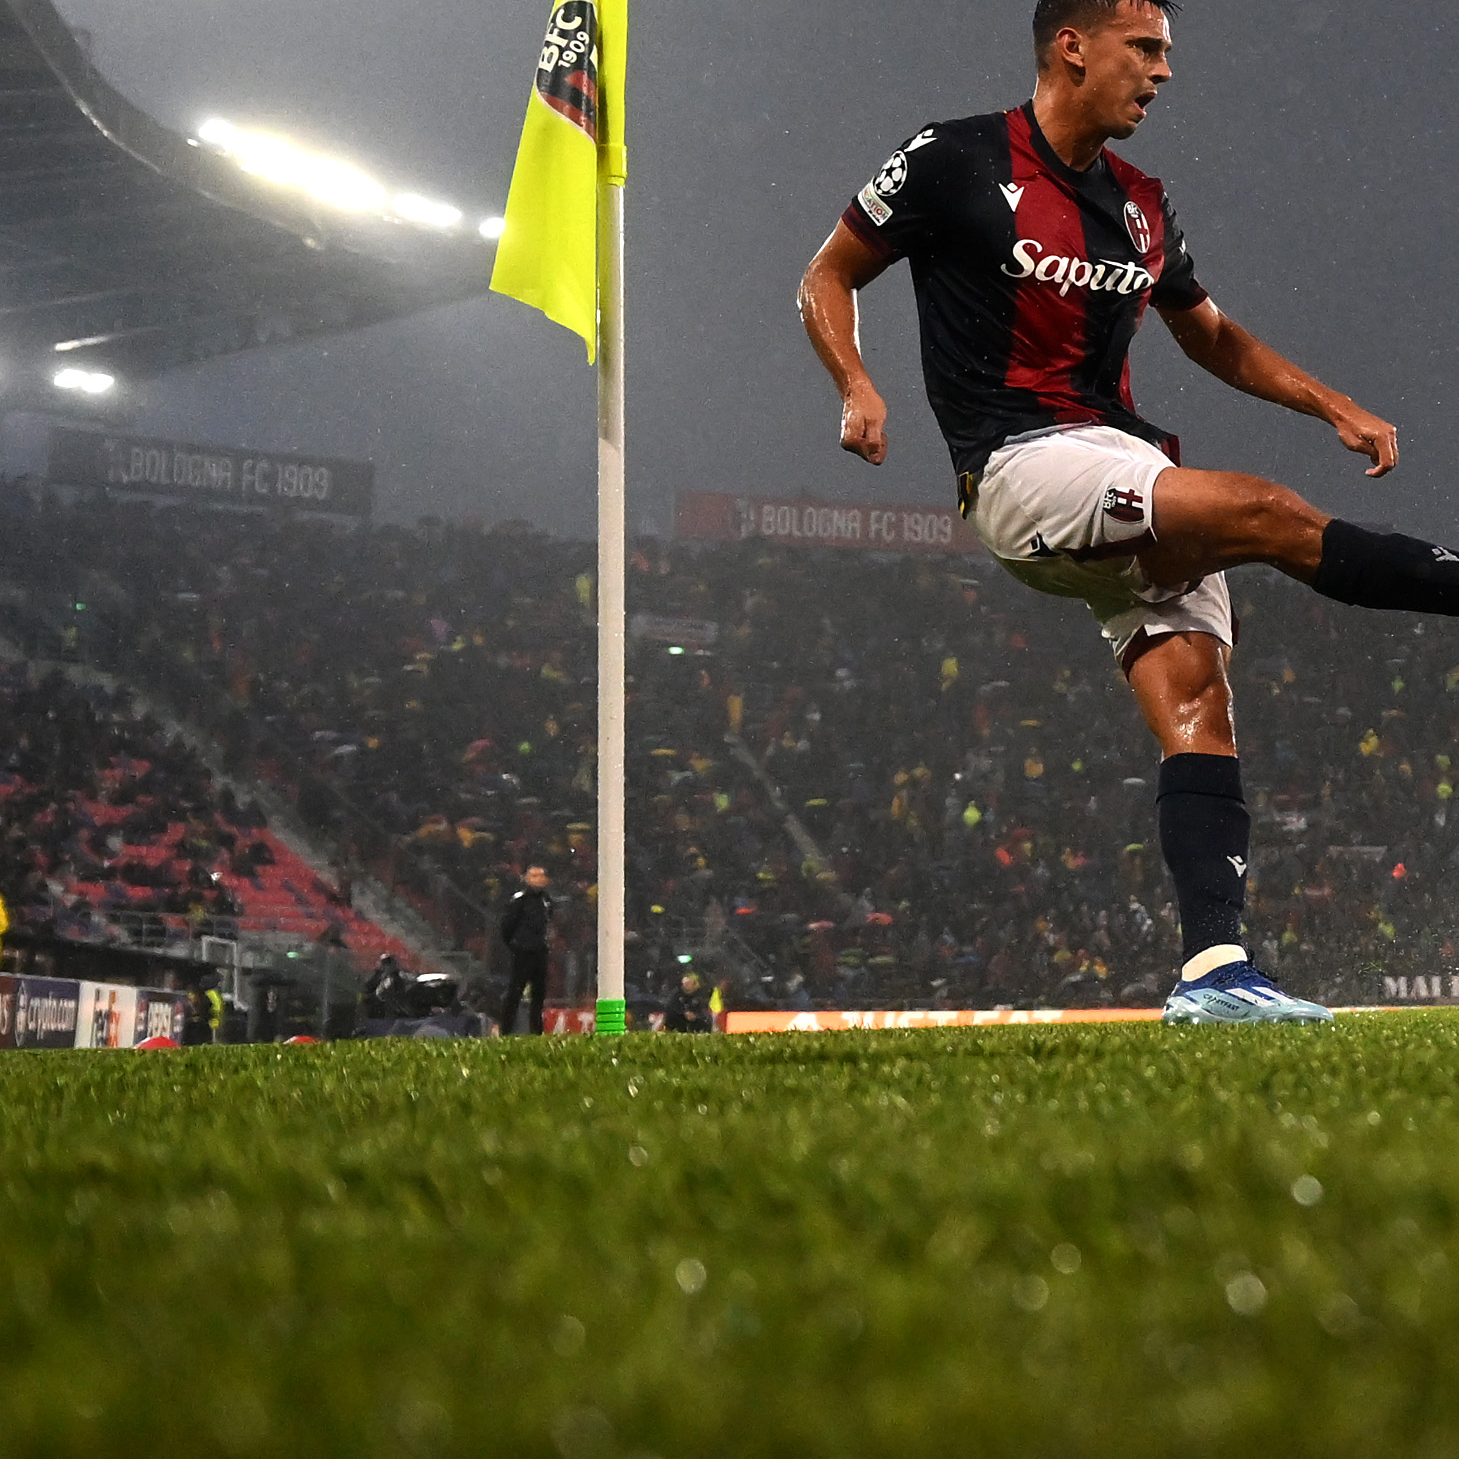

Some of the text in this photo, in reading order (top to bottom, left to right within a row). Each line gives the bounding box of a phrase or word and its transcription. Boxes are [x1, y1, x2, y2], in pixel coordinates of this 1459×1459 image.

[538, 8, 583, 73] BFC
[558, 30, 590, 68] 1909
[1000, 239, 1155, 298] Saputo
[130, 447, 332, 500] BOLOGNA FC 1909
[762, 504, 952, 544] BOLOGNA FC 1909
[1384, 975, 1442, 998] MAI
